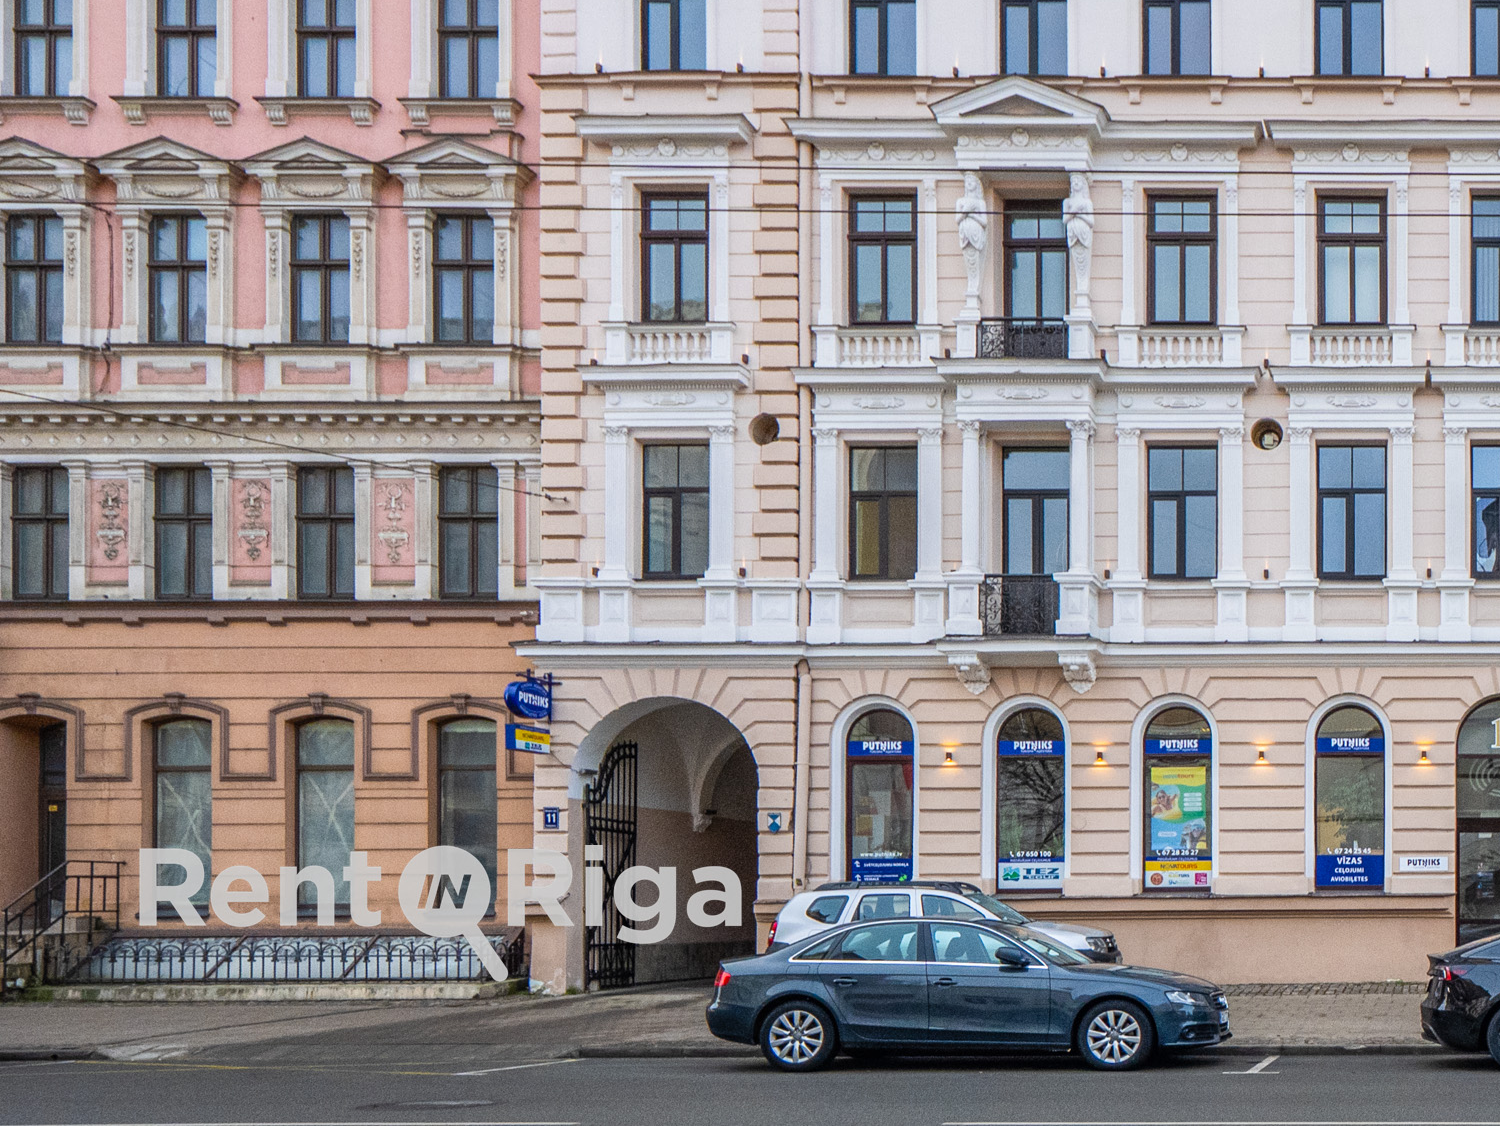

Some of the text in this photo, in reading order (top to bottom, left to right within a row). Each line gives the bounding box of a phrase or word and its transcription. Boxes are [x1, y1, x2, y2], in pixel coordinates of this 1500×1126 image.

[546, 813, 556, 823] 11
[1337, 856, 1362, 865] VĪZAS
[1022, 867, 1060, 875] TEZ
